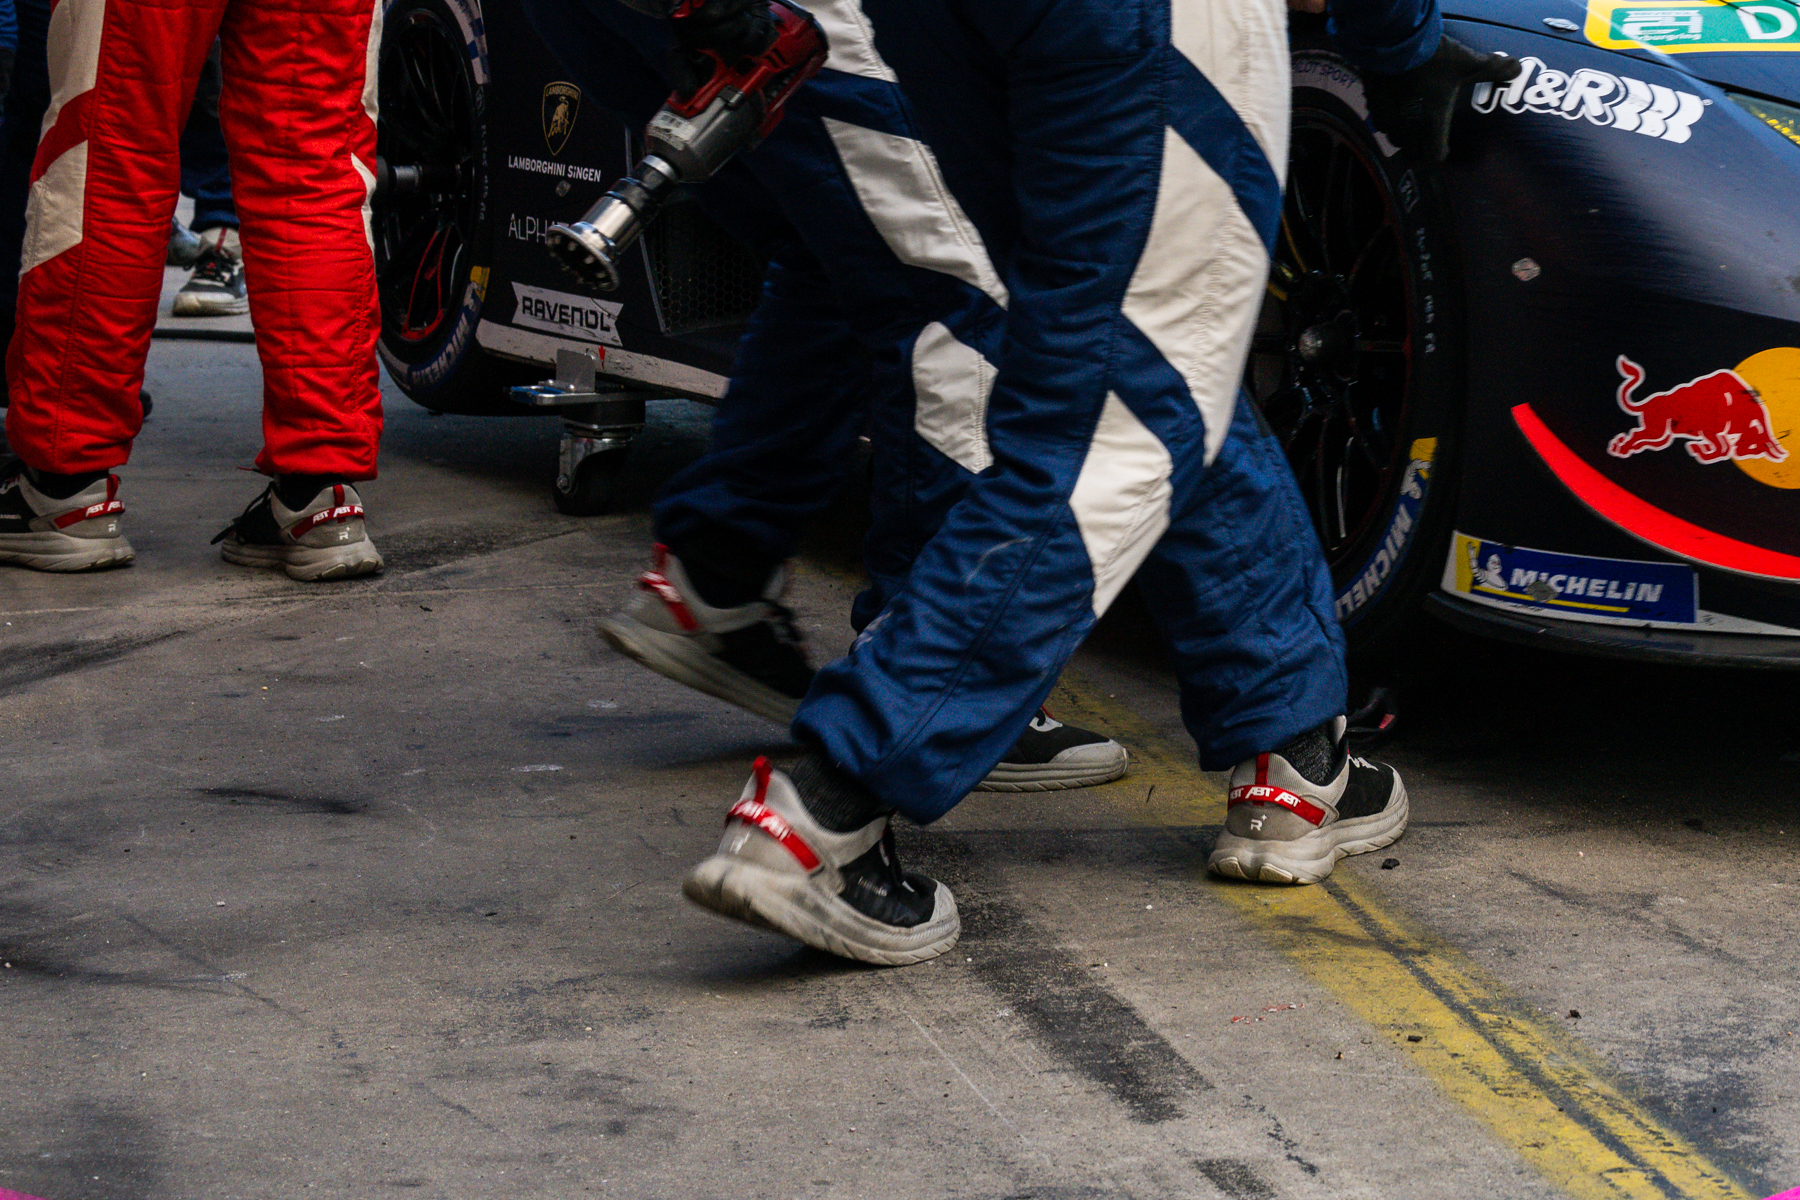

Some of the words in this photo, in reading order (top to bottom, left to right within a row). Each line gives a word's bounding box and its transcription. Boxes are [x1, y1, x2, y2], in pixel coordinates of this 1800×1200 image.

[508, 155, 566, 177] LAMBORGHINI
[521, 295, 612, 333] RAVENOL
[1245, 786, 1274, 799] ABT
[1274, 791, 1301, 808] ABT
